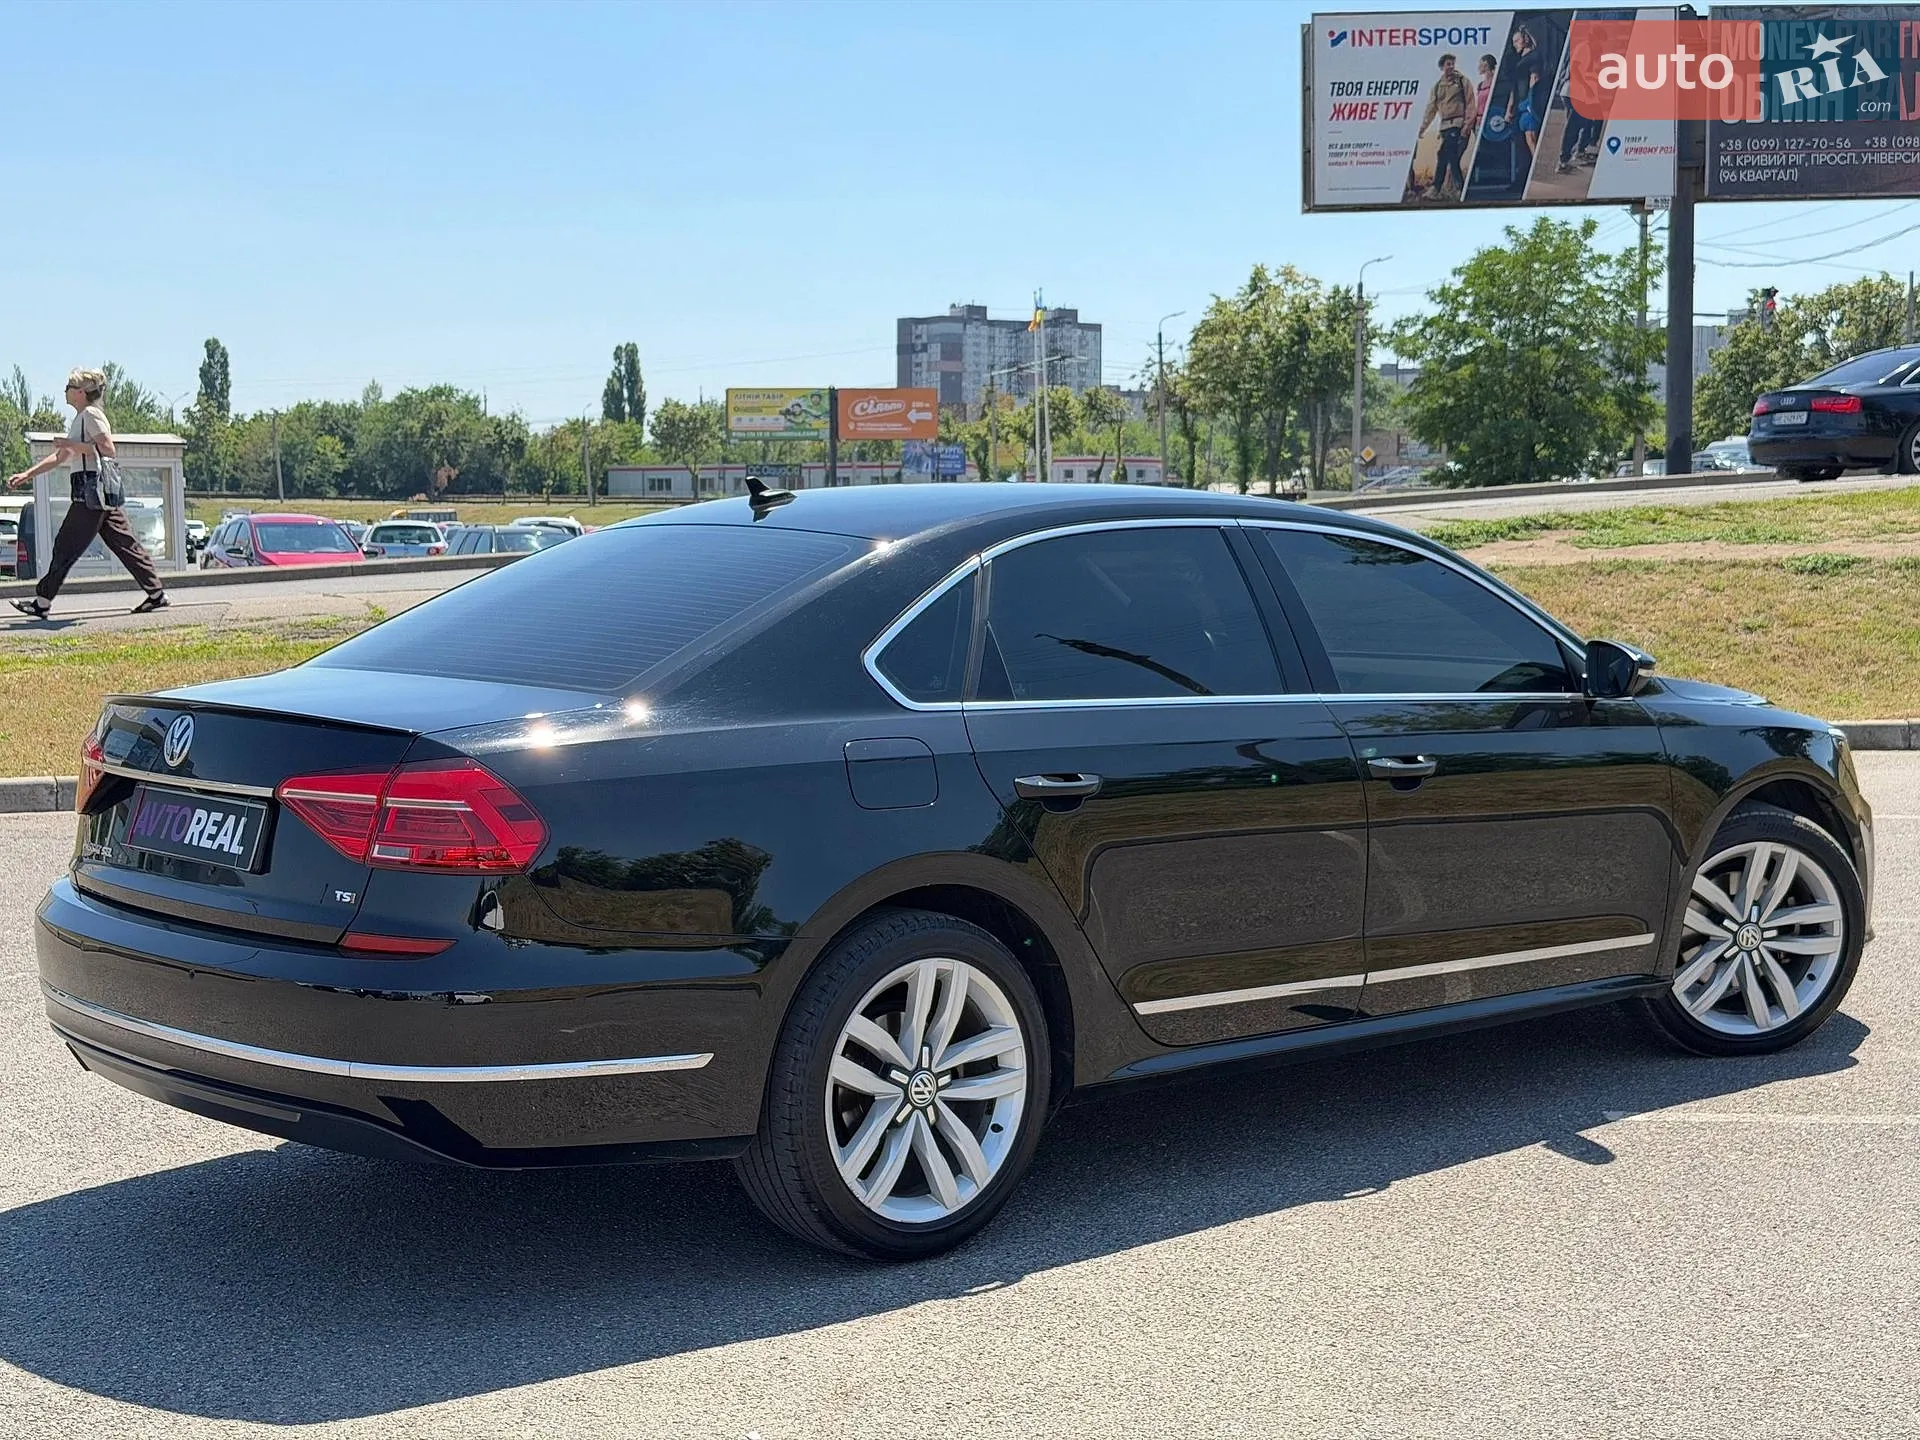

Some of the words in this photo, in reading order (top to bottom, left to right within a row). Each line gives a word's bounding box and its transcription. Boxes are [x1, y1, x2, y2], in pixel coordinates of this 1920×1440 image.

[1351, 27, 1491, 47] INTERSPORT
[1330, 81, 1363, 97] ТВОЯ
[1366, 79, 1419, 96] ЕНЕРГІЯ
[1329, 102, 1379, 121] ЖИВЕ
[1384, 102, 1413, 120] ТУТ
[1719, 139, 1742, 150] +38
[1746, 138, 1780, 151] (099)
[1784, 137, 1852, 149] 127-70-56
[1865, 137, 1887, 148] +38
[1891, 135, 1920, 149] (098
[1719, 154, 1733, 167] М.
[1736, 152, 1786, 167] КРИВИЙ
[1788, 153, 1808, 168] РІГ,
[1811, 153, 1858, 166] ПРОСП.
[1861, 151, 1920, 165] УНІВЕРСИ
[1719, 170, 1737, 183] (96
[1739, 168, 1798, 182] КВАРТАЛ)
[135, 800, 248, 855] AVTOREAL
